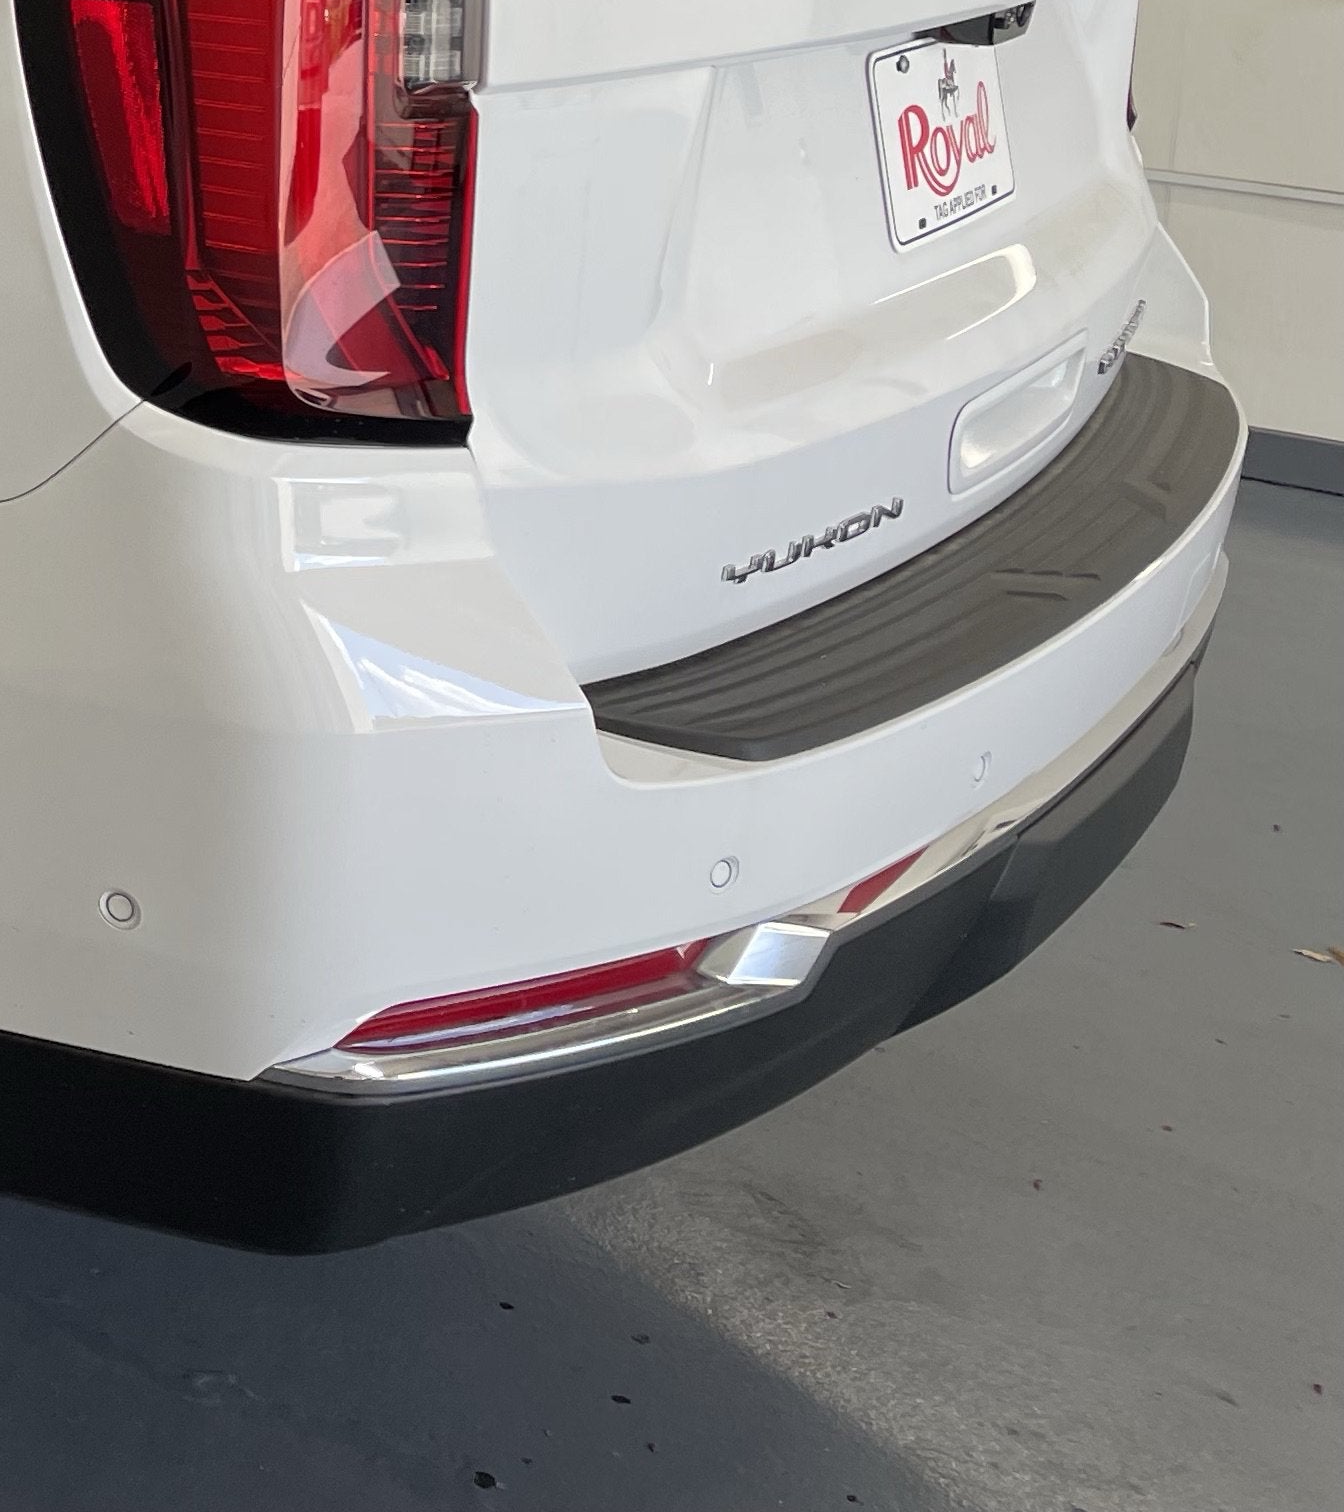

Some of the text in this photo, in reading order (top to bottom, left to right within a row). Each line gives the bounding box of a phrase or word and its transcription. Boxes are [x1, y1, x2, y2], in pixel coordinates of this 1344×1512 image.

[898, 80, 997, 197] Royal
[934, 201, 949, 220] TAG
[721, 496, 904, 584] YUKON
